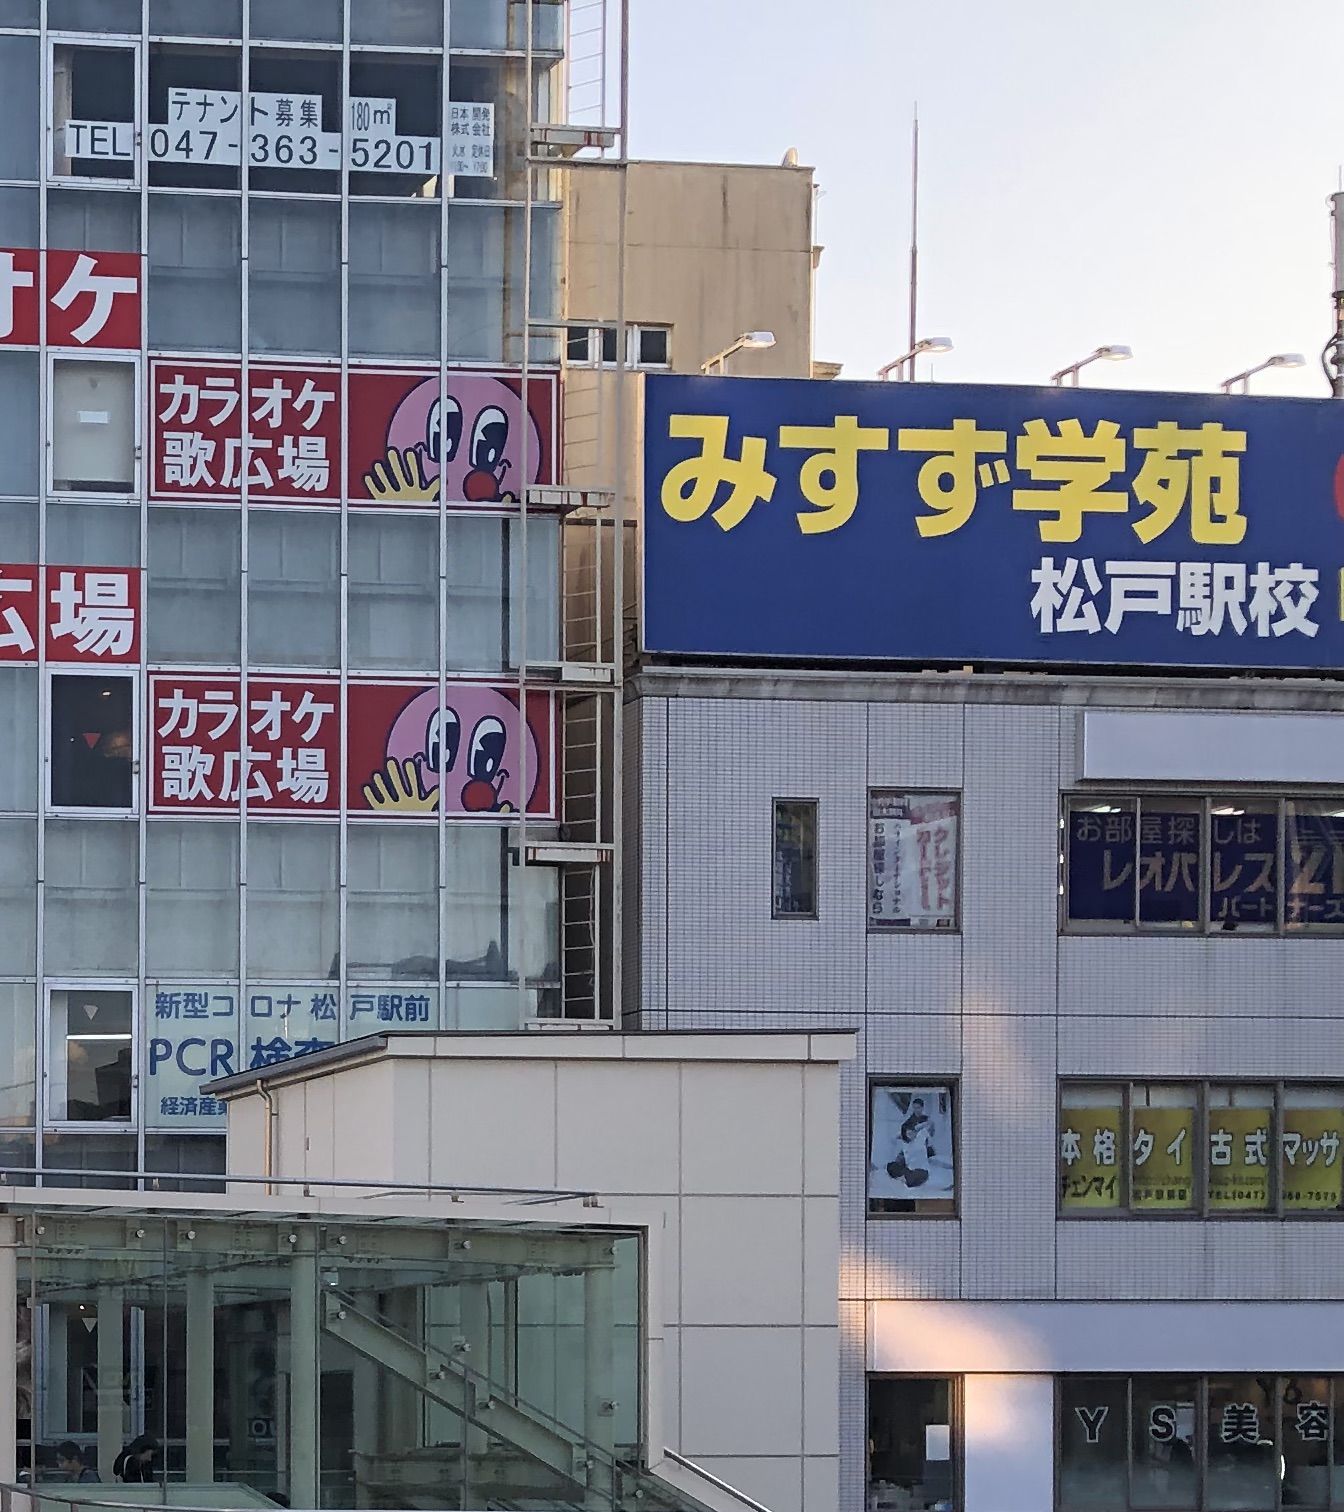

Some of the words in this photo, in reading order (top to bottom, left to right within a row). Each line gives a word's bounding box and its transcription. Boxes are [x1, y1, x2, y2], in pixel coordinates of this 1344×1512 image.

[171, 91, 319, 128] テナント募集
[69, 123, 131, 157] TEL
[159, 374, 335, 431] カラオケ
[163, 430, 330, 492] 歌広場
[661, 414, 1247, 545] みすず学苑
[1030, 556, 1320, 637] 松戸駅校
[158, 688, 334, 743] カラオケ
[162, 744, 329, 803] 歌広場
[1077, 816, 1261, 844] お部屋探しは
